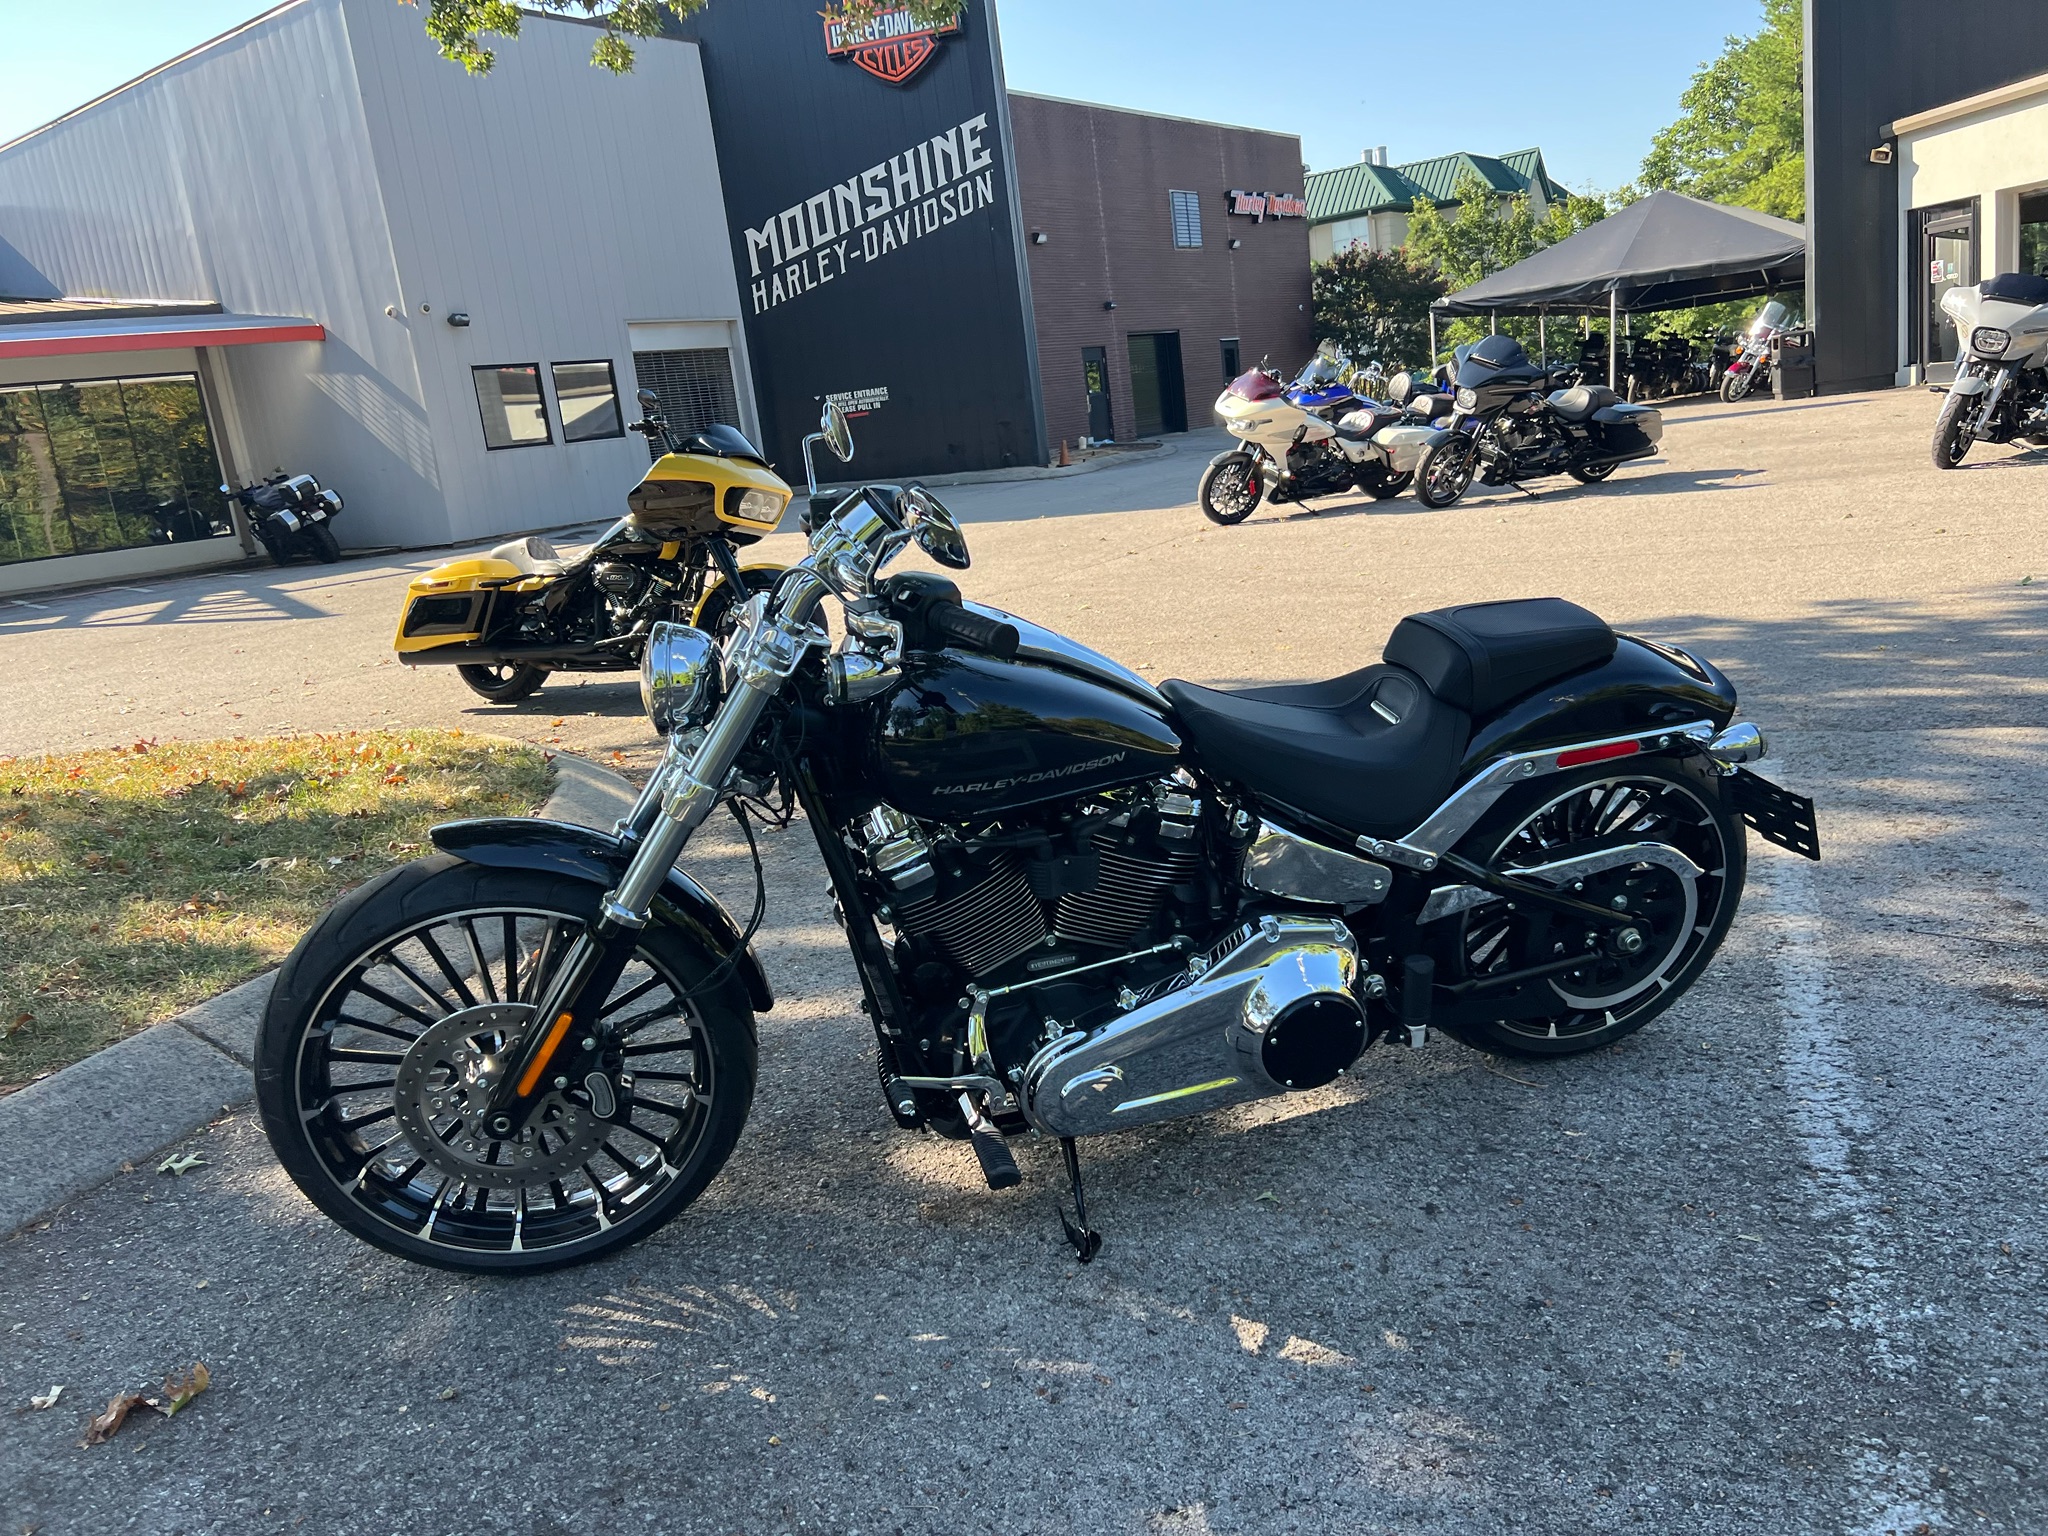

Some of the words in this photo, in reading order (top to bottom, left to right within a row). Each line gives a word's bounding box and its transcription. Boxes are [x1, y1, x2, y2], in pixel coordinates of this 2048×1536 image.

[863, 39, 924, 75] CYCLES
[744, 112, 993, 277] MOONSHINE
[1231, 190, 1266, 223] Harley
[1264, 192, 1309, 220] Davidson
[751, 169, 995, 315] HARLEY-DAVIDSON
[825, 392, 852, 402] SERVICE
[853, 387, 888, 399] ENTRANCE
[857, 403, 872, 411] PULL
[932, 751, 1126, 795] HARLEY-DAVIDSON
